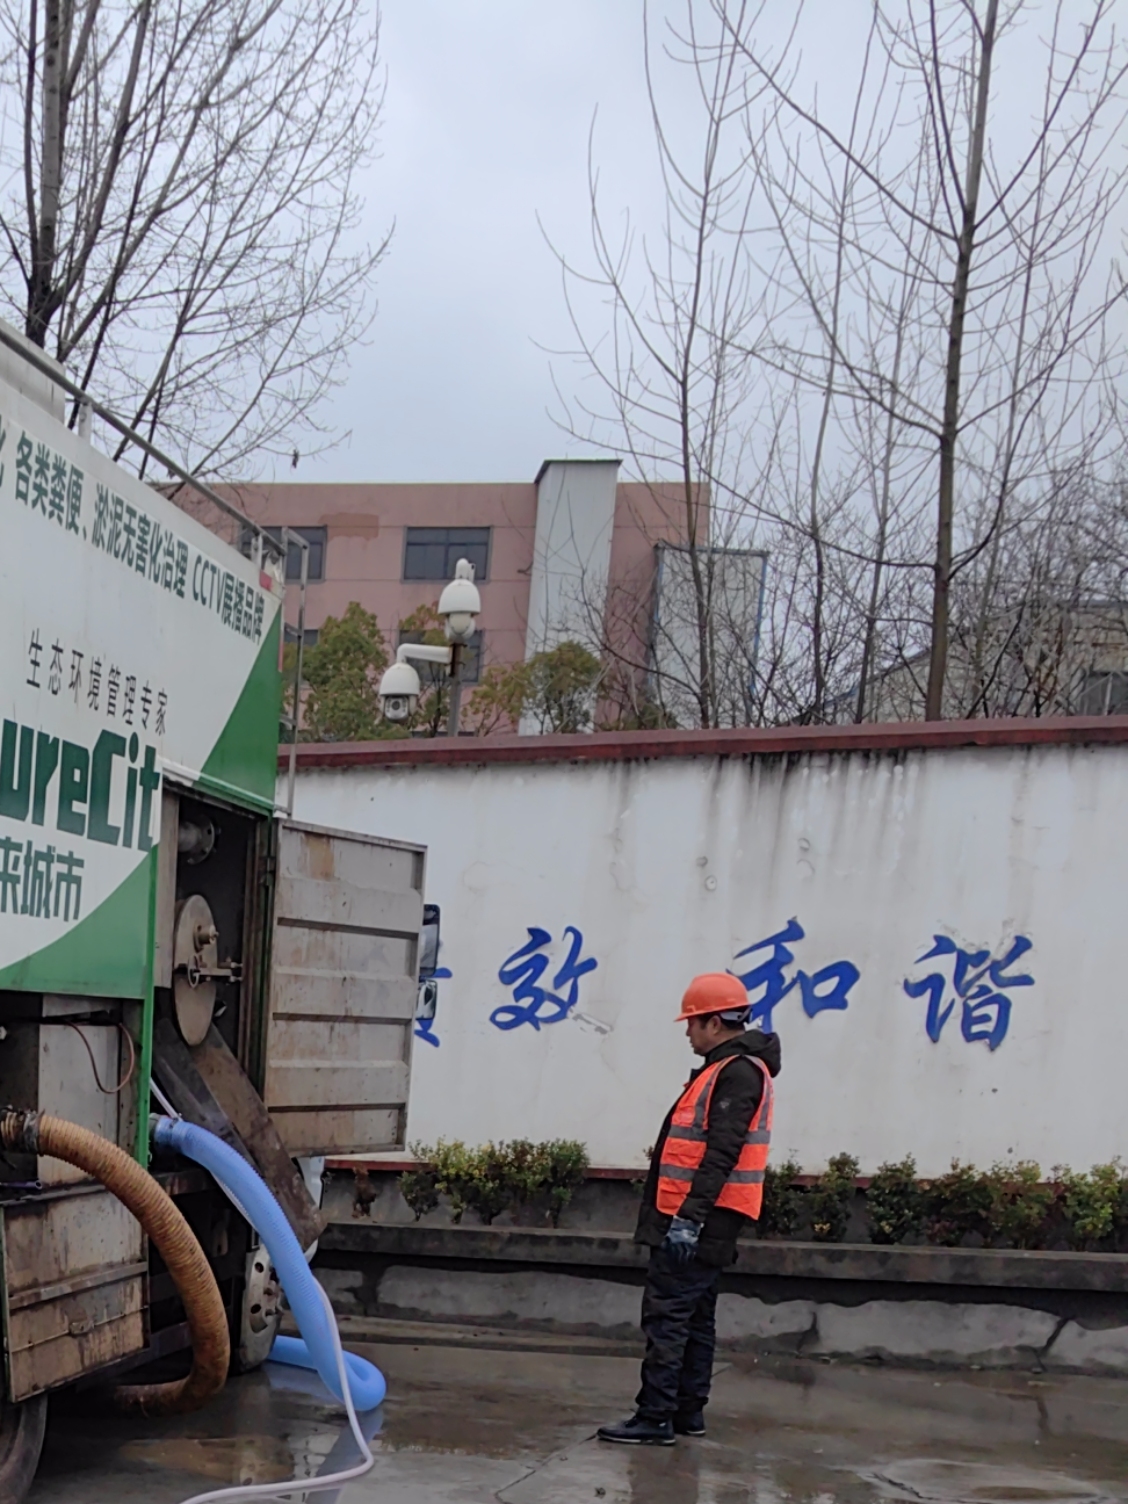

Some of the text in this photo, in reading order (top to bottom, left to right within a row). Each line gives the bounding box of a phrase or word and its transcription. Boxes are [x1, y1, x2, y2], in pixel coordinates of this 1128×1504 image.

[193, 554, 266, 646] CCTV展播品牌
[26, 627, 168, 736] 生态环境管理专家
[726, 916, 1036, 1051] 和谐
